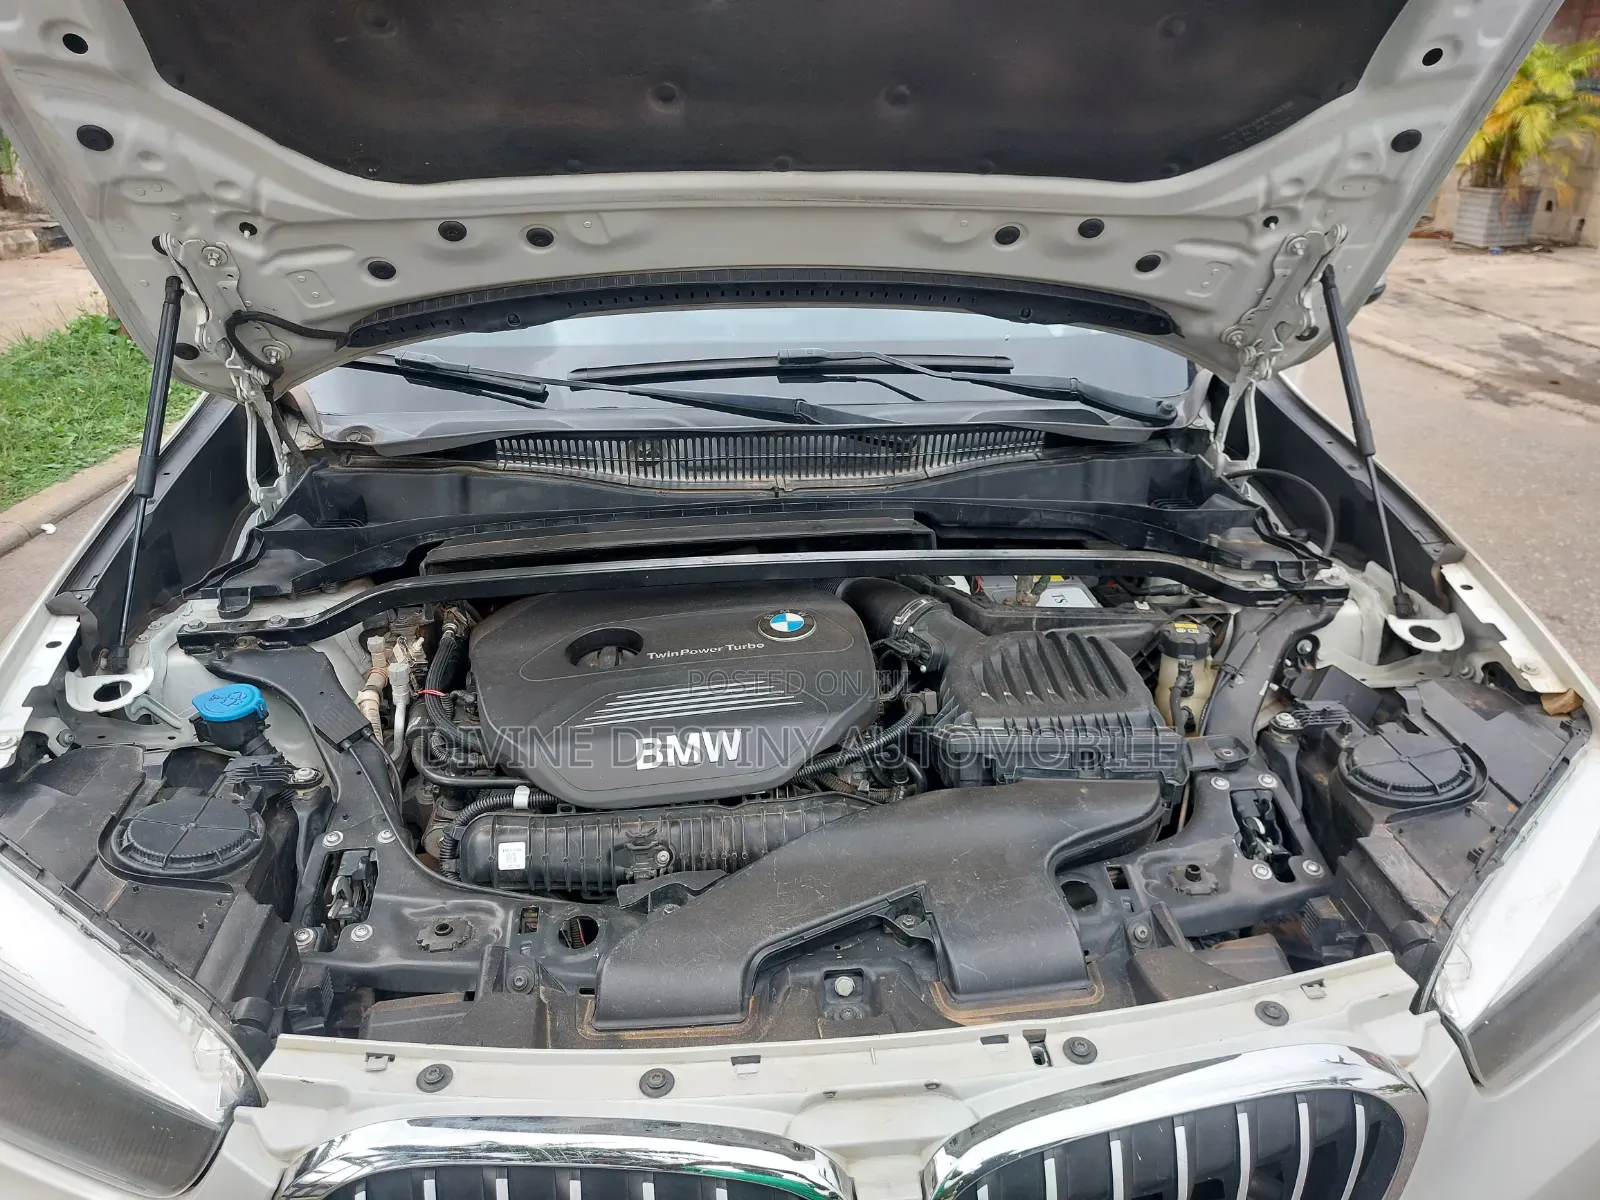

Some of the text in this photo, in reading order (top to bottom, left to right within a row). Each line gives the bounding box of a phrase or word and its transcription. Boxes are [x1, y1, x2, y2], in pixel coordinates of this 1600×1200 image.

[647, 642, 765, 660] TwinPower Turbo
[635, 728, 742, 771] BMW
